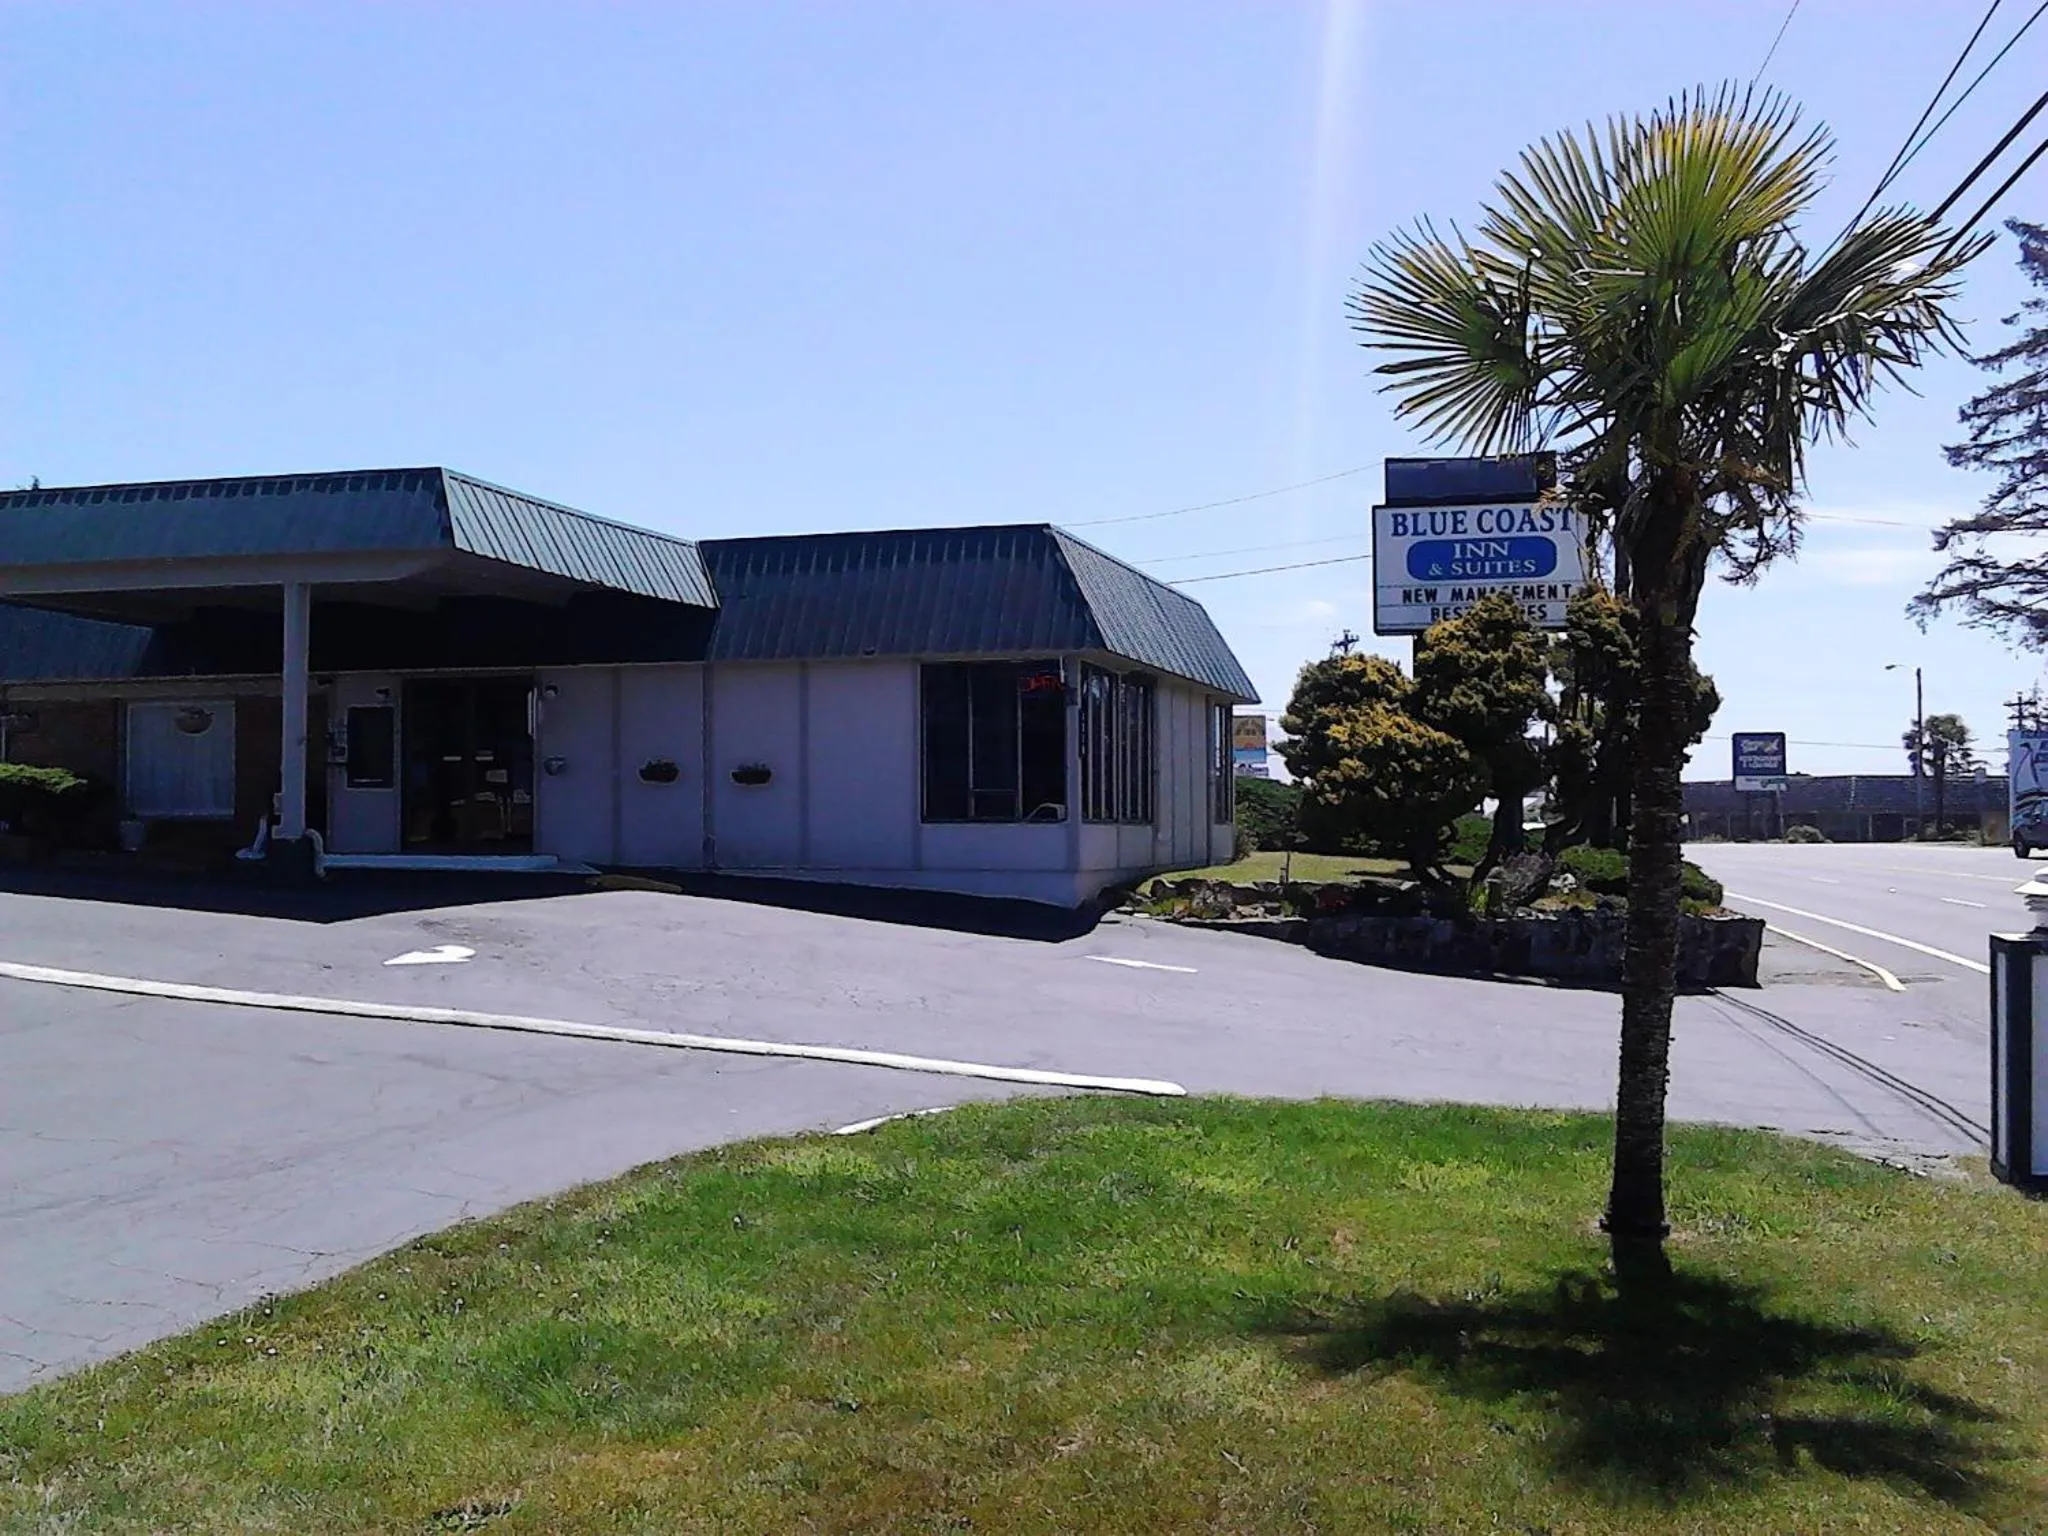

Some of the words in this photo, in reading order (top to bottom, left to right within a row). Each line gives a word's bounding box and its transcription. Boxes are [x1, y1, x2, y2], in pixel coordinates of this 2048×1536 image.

[1391, 510, 1468, 537] BLUE
[1477, 507, 1574, 534] COAST
[1453, 541, 1511, 559] INN
[1428, 562, 1443, 577] &
[1451, 559, 1537, 576] SUITES
[1402, 587, 1438, 604] NEW
[1450, 583, 1572, 603] MANEMENT
[1430, 606, 1472, 622] BES
